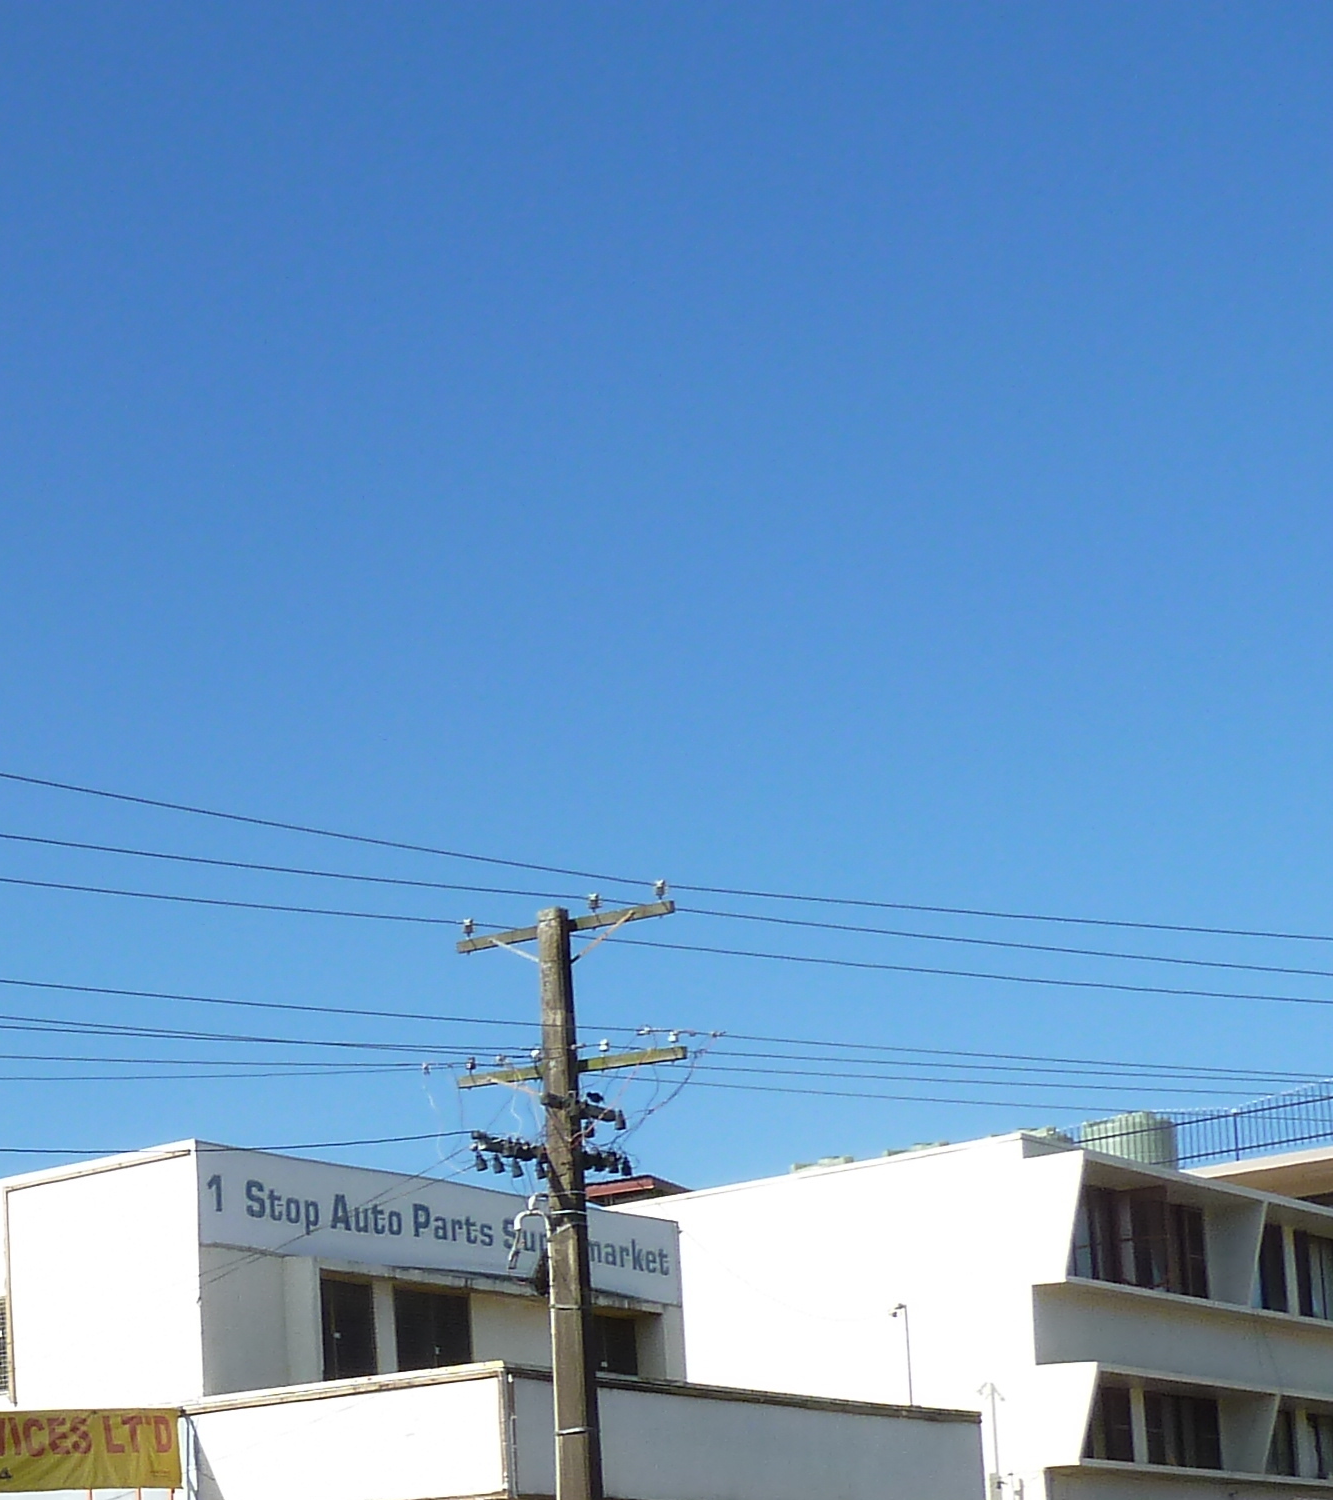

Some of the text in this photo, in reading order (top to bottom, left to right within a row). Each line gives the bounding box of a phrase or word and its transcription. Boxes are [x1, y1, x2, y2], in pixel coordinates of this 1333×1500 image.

[207, 1174, 670, 1276] 1 Stop Auto Parts Sumarket
